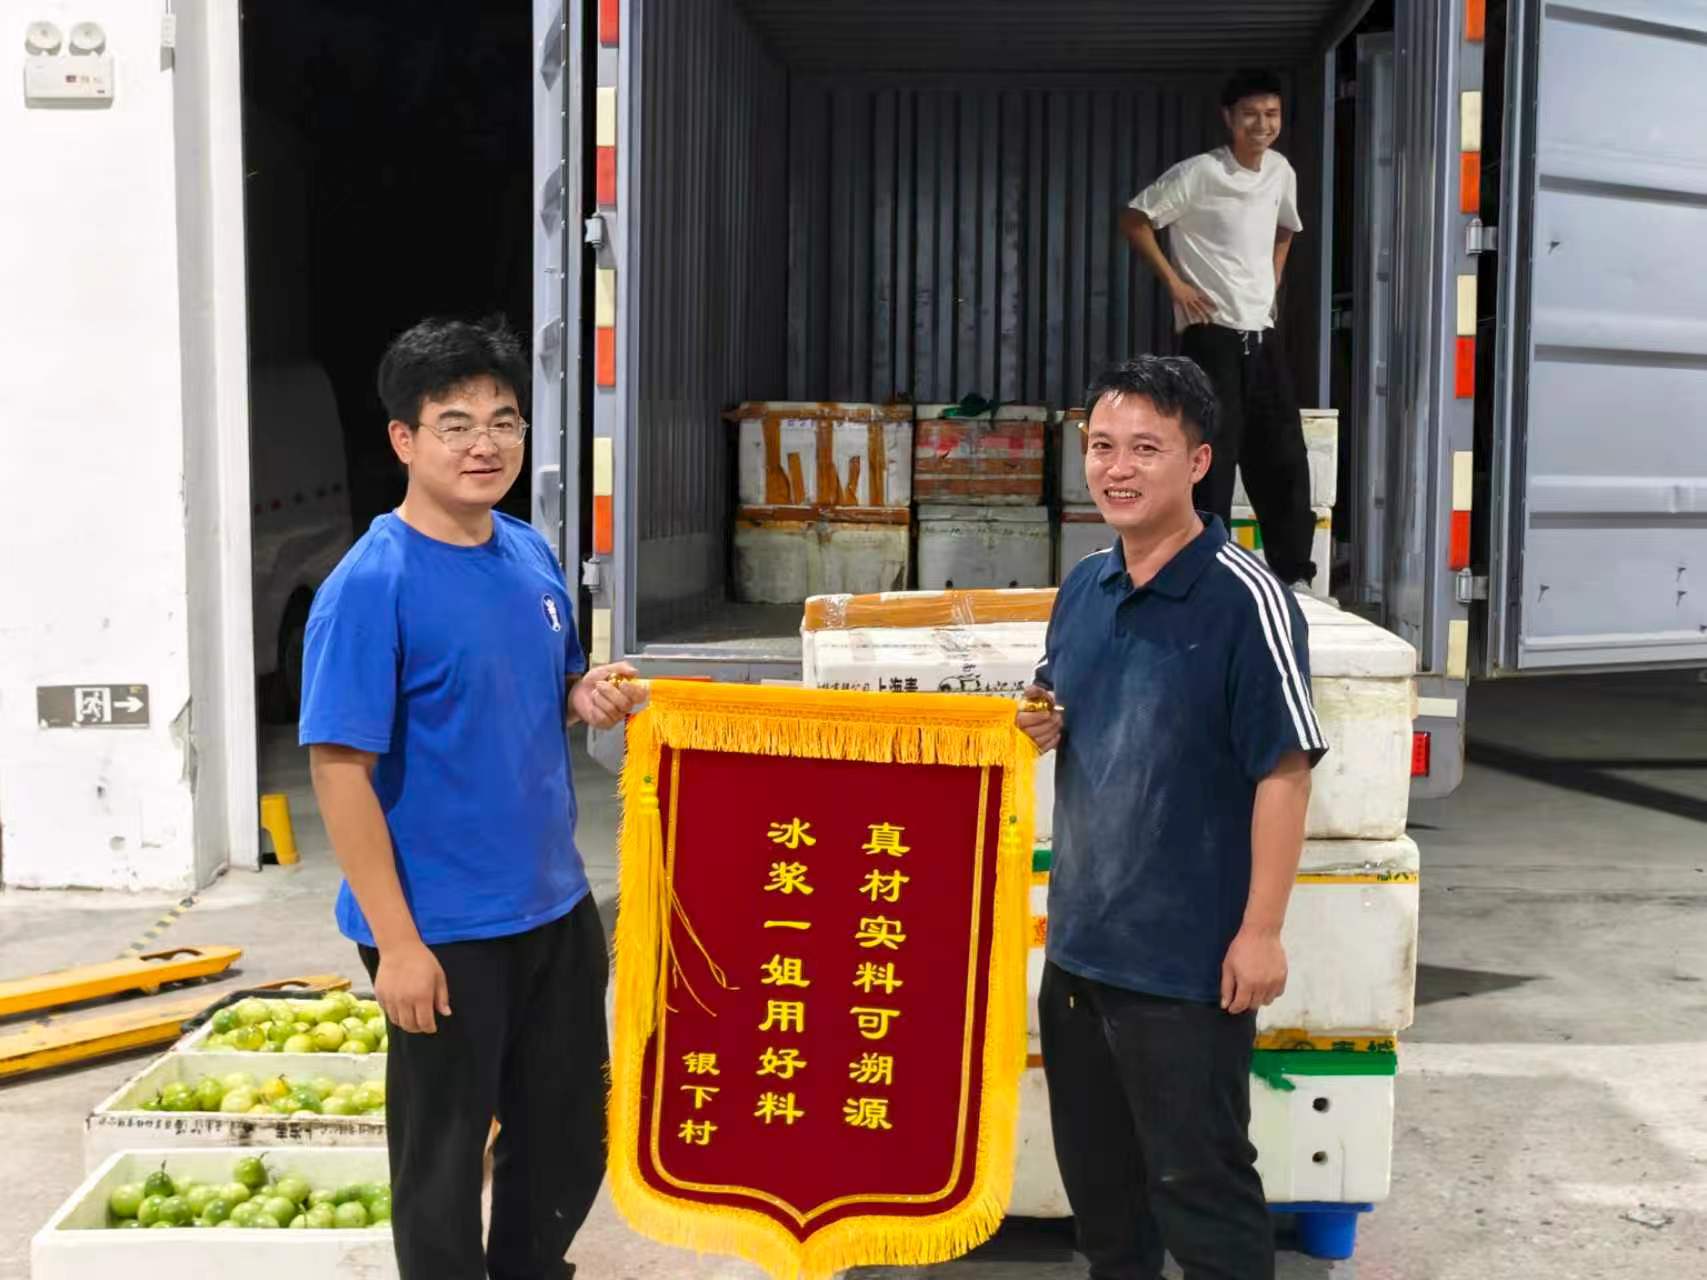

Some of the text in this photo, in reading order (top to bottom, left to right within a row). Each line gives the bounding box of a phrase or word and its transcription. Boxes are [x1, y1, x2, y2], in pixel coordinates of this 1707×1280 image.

[753, 817, 817, 1125] 冰浆一姐用好料
[678, 1051, 720, 1146] 银下村
